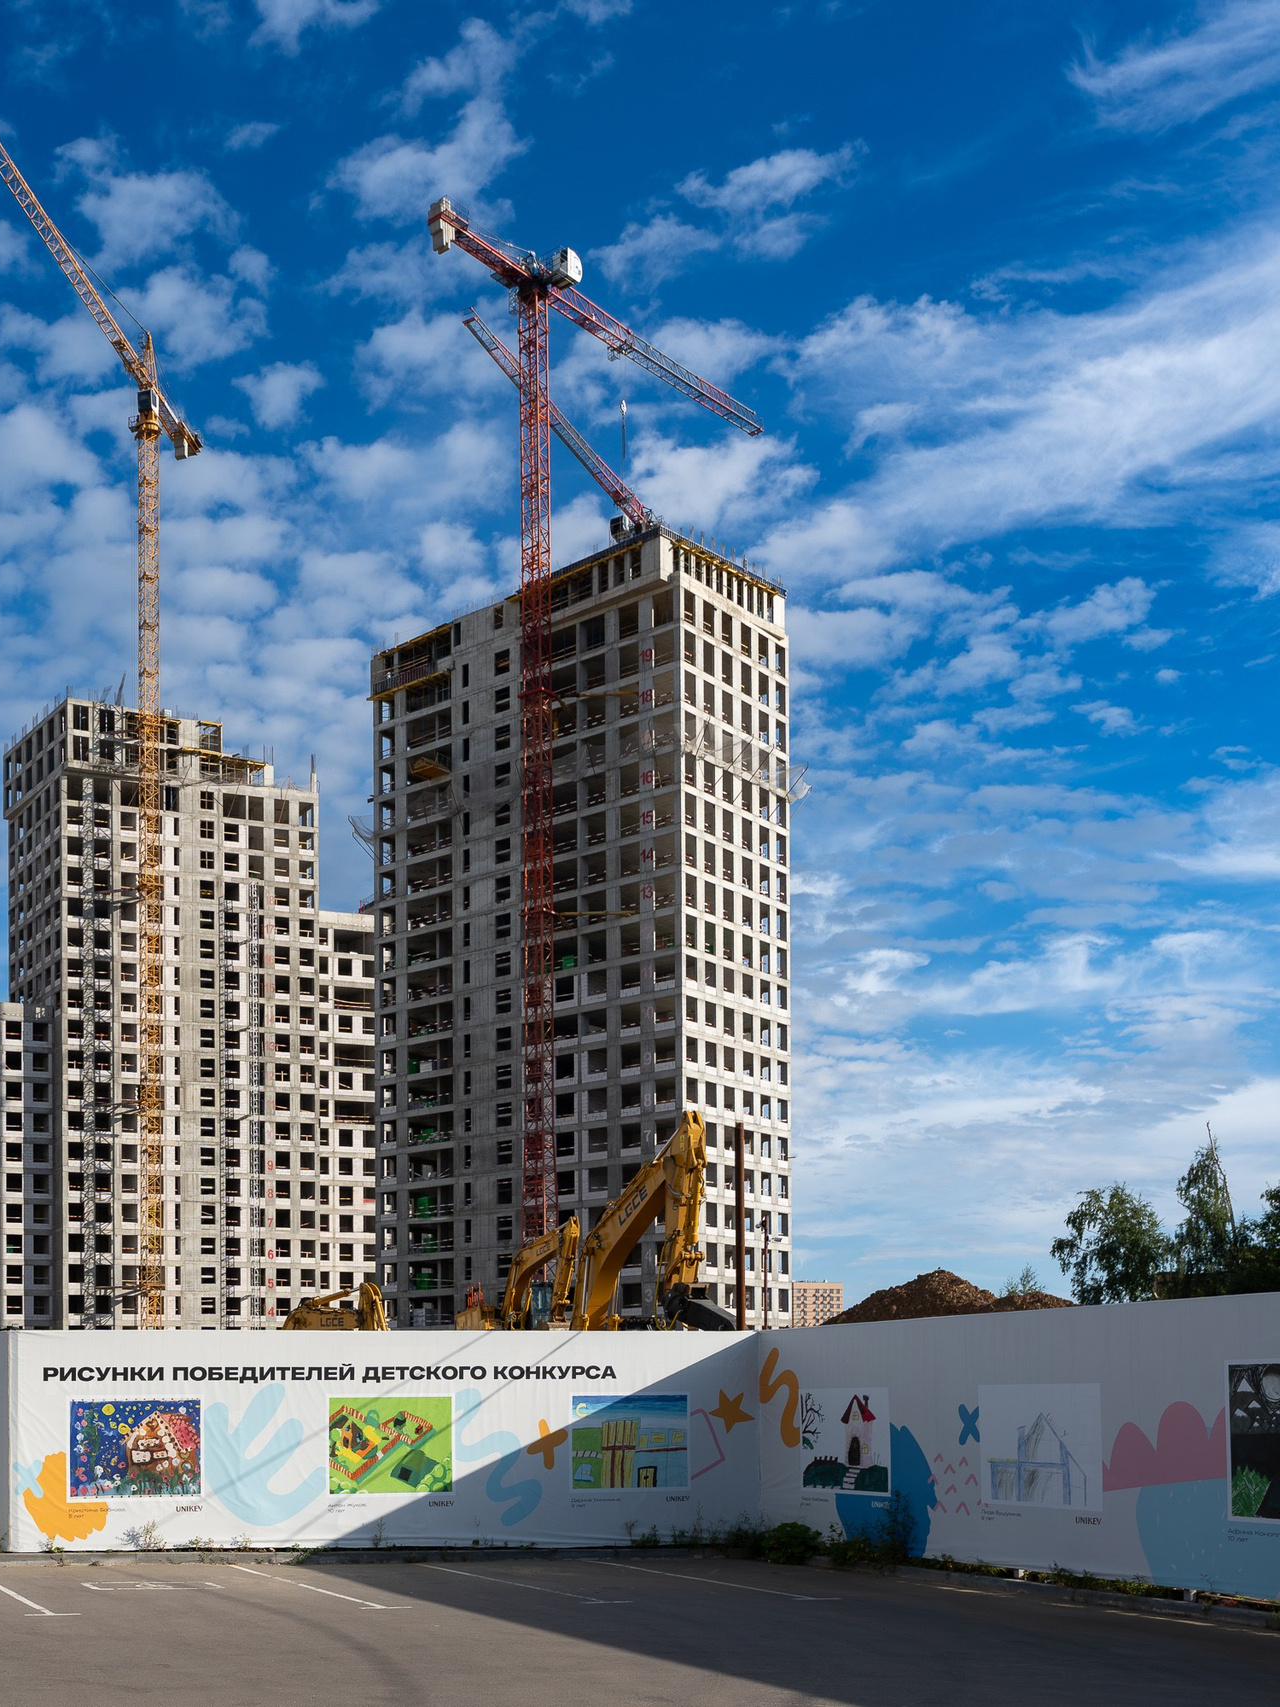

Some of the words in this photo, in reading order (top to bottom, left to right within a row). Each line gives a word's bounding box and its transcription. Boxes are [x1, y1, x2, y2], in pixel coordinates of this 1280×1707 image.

[639, 648, 653, 663] 19
[639, 688, 653, 704] 18
[640, 770, 653, 785] 16
[640, 810, 653, 825] 15
[640, 847, 653, 862] 14
[641, 886, 653, 899] 13
[265, 924, 275, 934] 17
[266, 983, 275, 993] 15
[266, 1041, 275, 1051] 13
[644, 1052, 652, 1065] 9
[643, 1093, 652, 1107] 8
[643, 1130, 652, 1142] 7
[267, 1160, 274, 1171] 9
[267, 1188, 274, 1199] 8
[618, 1185, 648, 1226] LGCE
[267, 1218, 274, 1227] 7
[267, 1249, 274, 1260] 6
[644, 1249, 652, 1262] 4
[267, 1278, 274, 1289] 5
[645, 1289, 653, 1303] 3
[267, 1306, 275, 1317] 4
[320, 1317, 344, 1327] LGCE
[42, 1366, 164, 1381] РИСУНКИ
[172, 1363, 355, 1383] ПОБЕДИТЕЛЕЙ
[362, 1365, 487, 1383] ДЕТСКОГО
[493, 1365, 617, 1380] КОНКУРСА
[175, 1505, 204, 1513] UNIKEY
[428, 1500, 455, 1508] UNIKEY
[1075, 1516, 1102, 1526] UNIKEY
